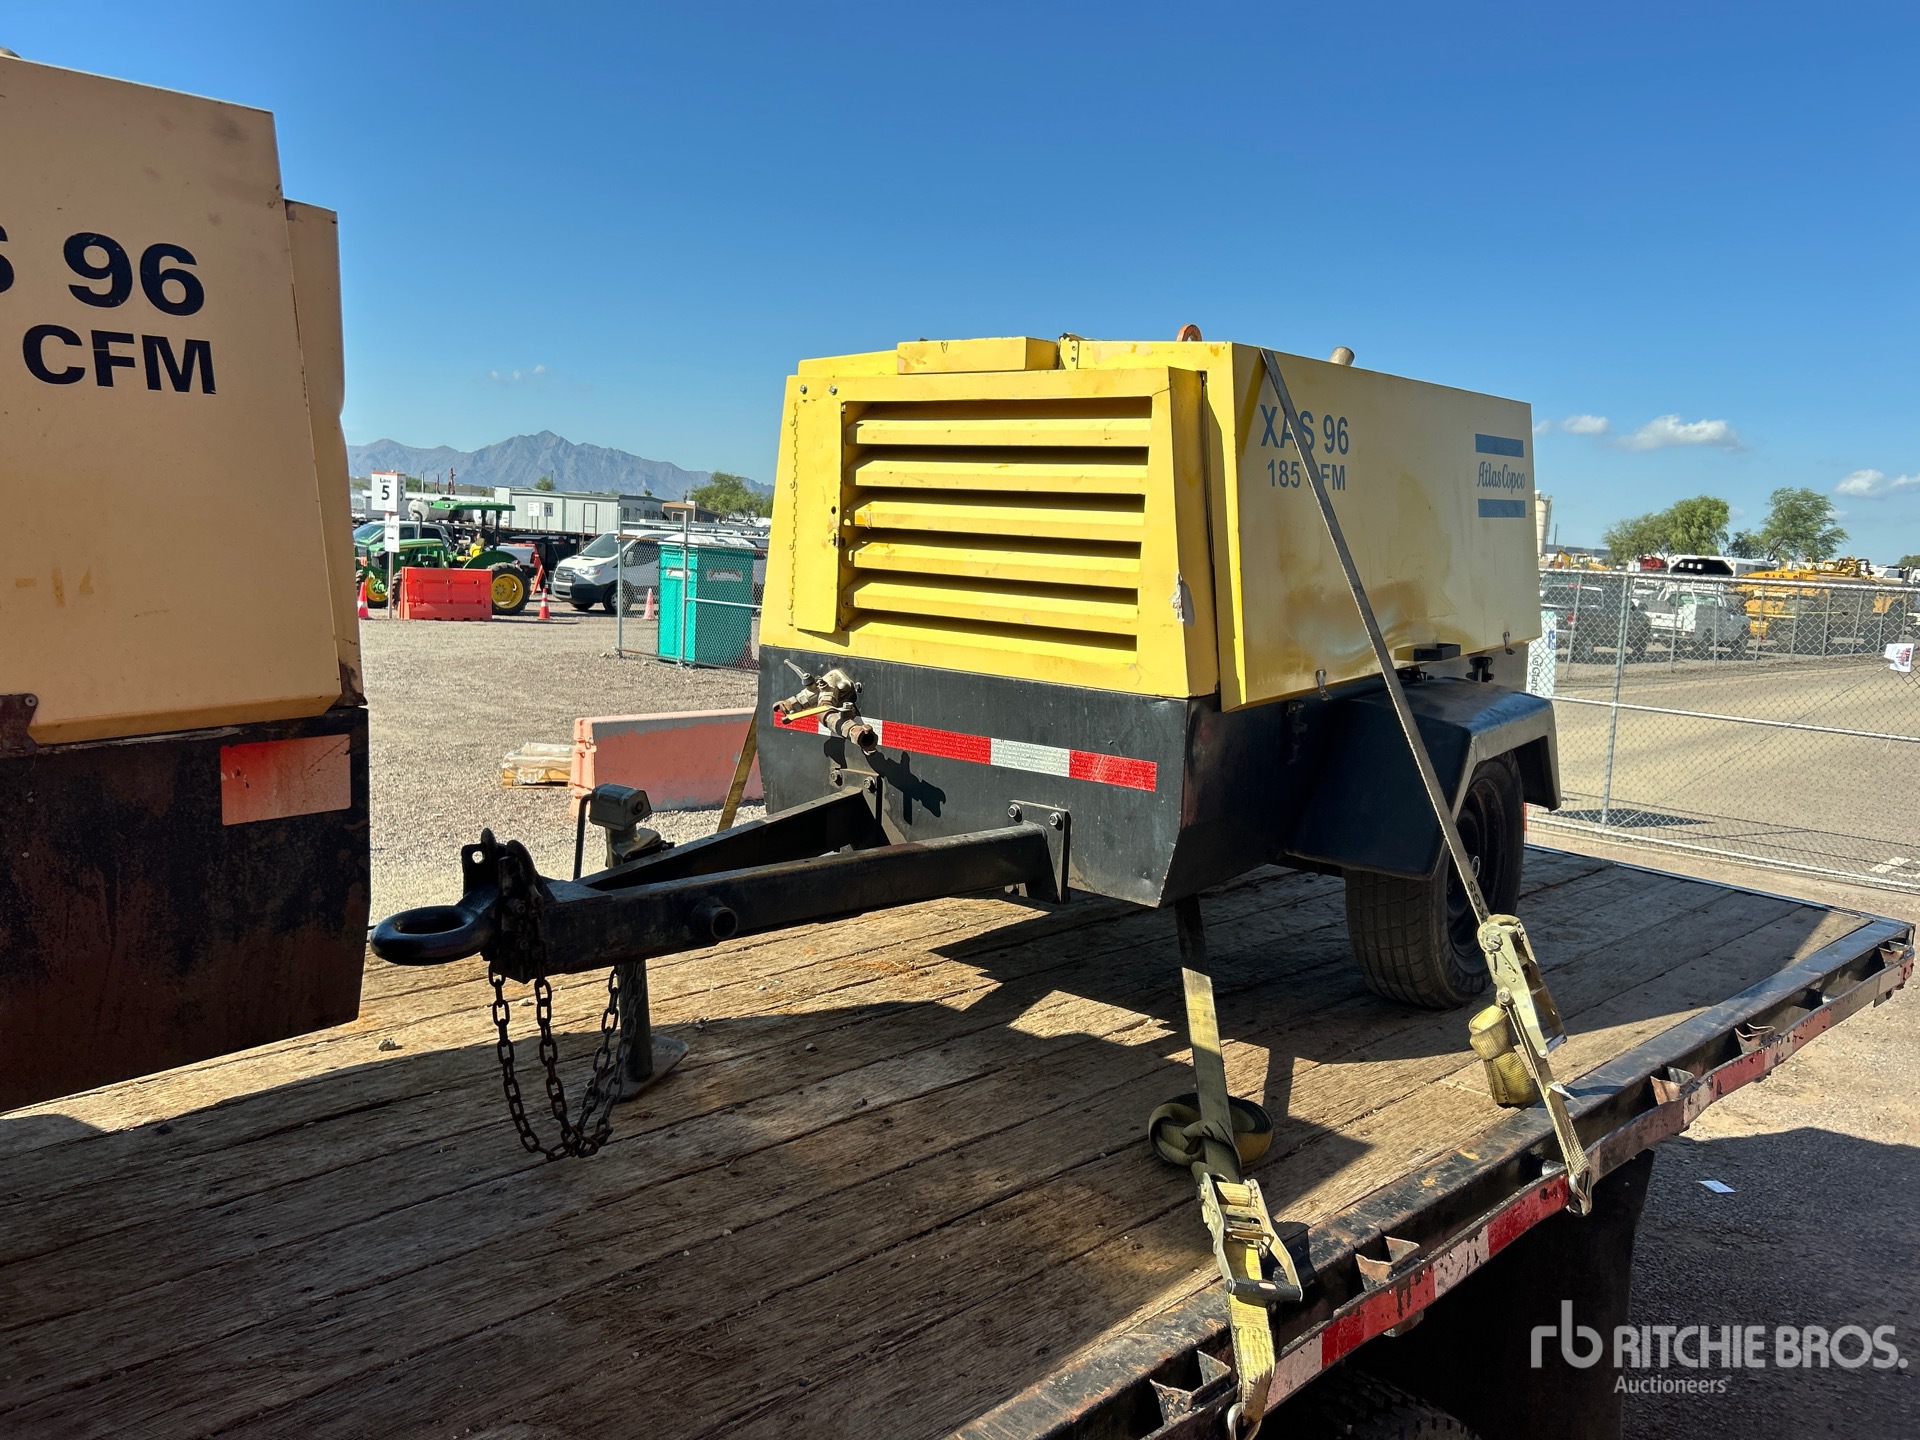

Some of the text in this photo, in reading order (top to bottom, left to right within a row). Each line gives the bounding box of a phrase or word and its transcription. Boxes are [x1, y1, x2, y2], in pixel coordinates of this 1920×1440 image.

[63, 232, 205, 316] 96
[22, 324, 217, 394] CFM
[1323, 414, 1349, 455] 96
[381, 484, 390, 500] 5
[1267, 459, 1346, 491] 185 FM
